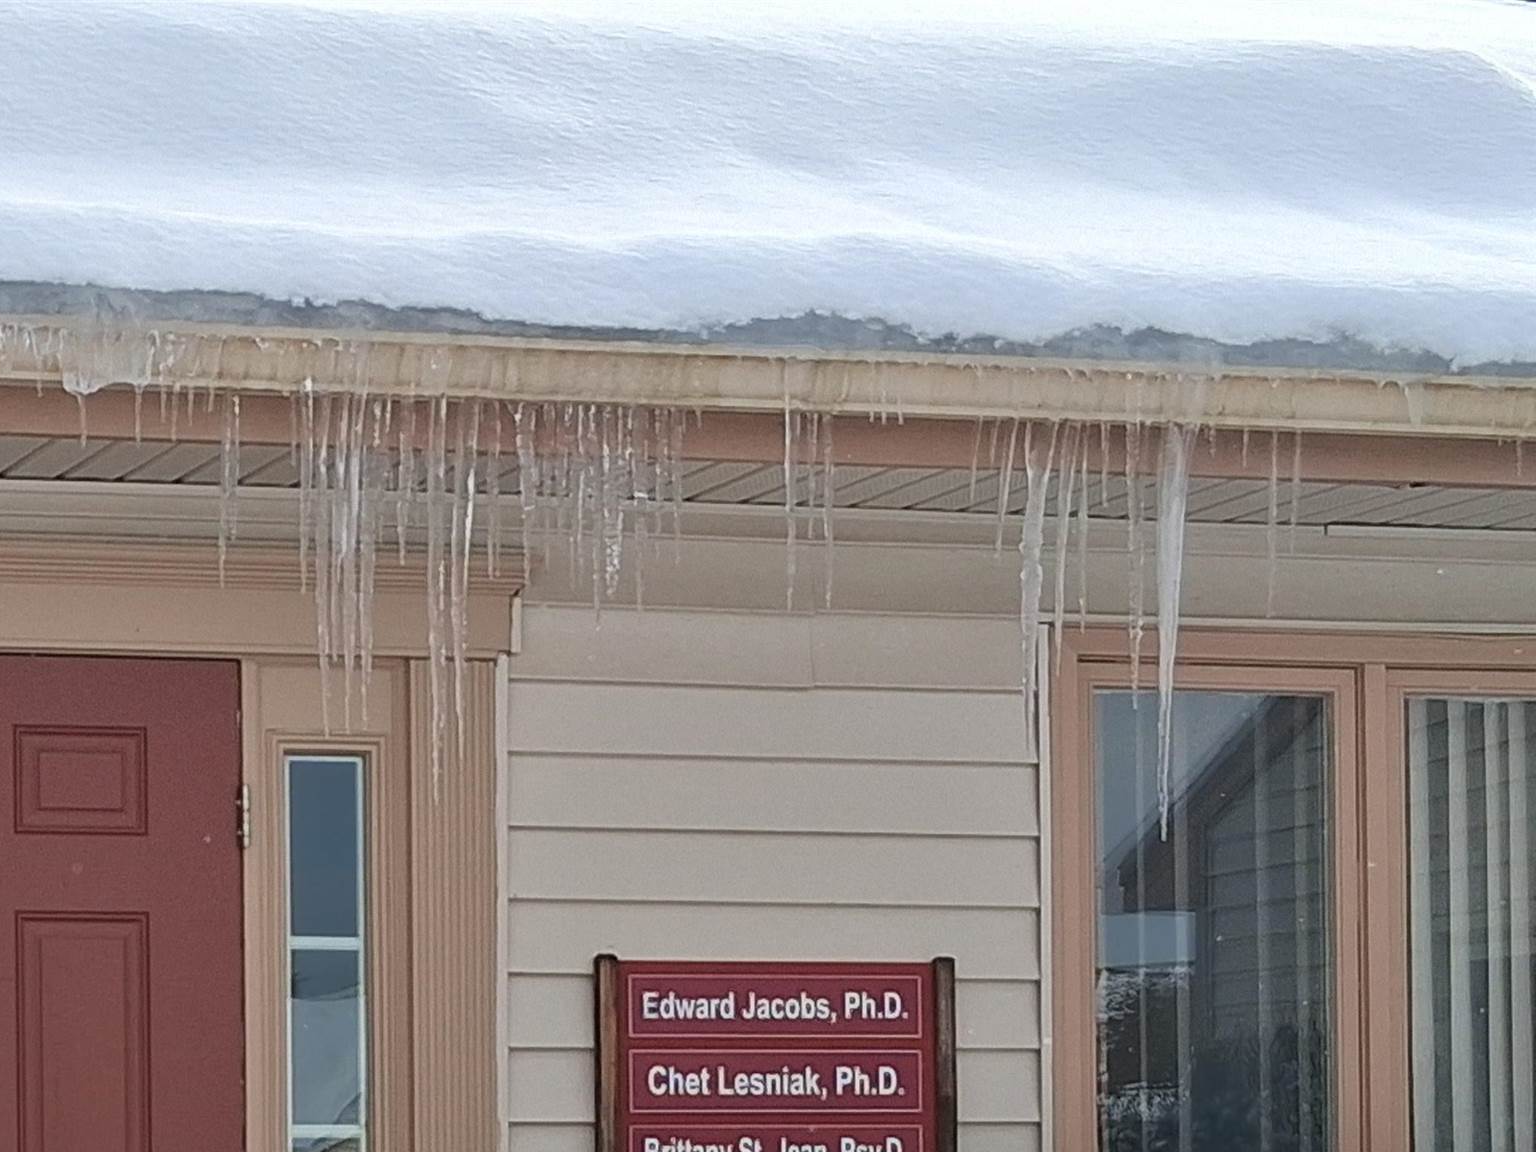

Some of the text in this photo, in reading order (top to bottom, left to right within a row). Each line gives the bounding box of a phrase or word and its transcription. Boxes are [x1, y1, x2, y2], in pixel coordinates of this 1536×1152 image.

[642, 991, 909, 1024] Edward Jacobs, Ph.D.
[648, 1065, 905, 1100] Chet Lesniak, Ph.D.
